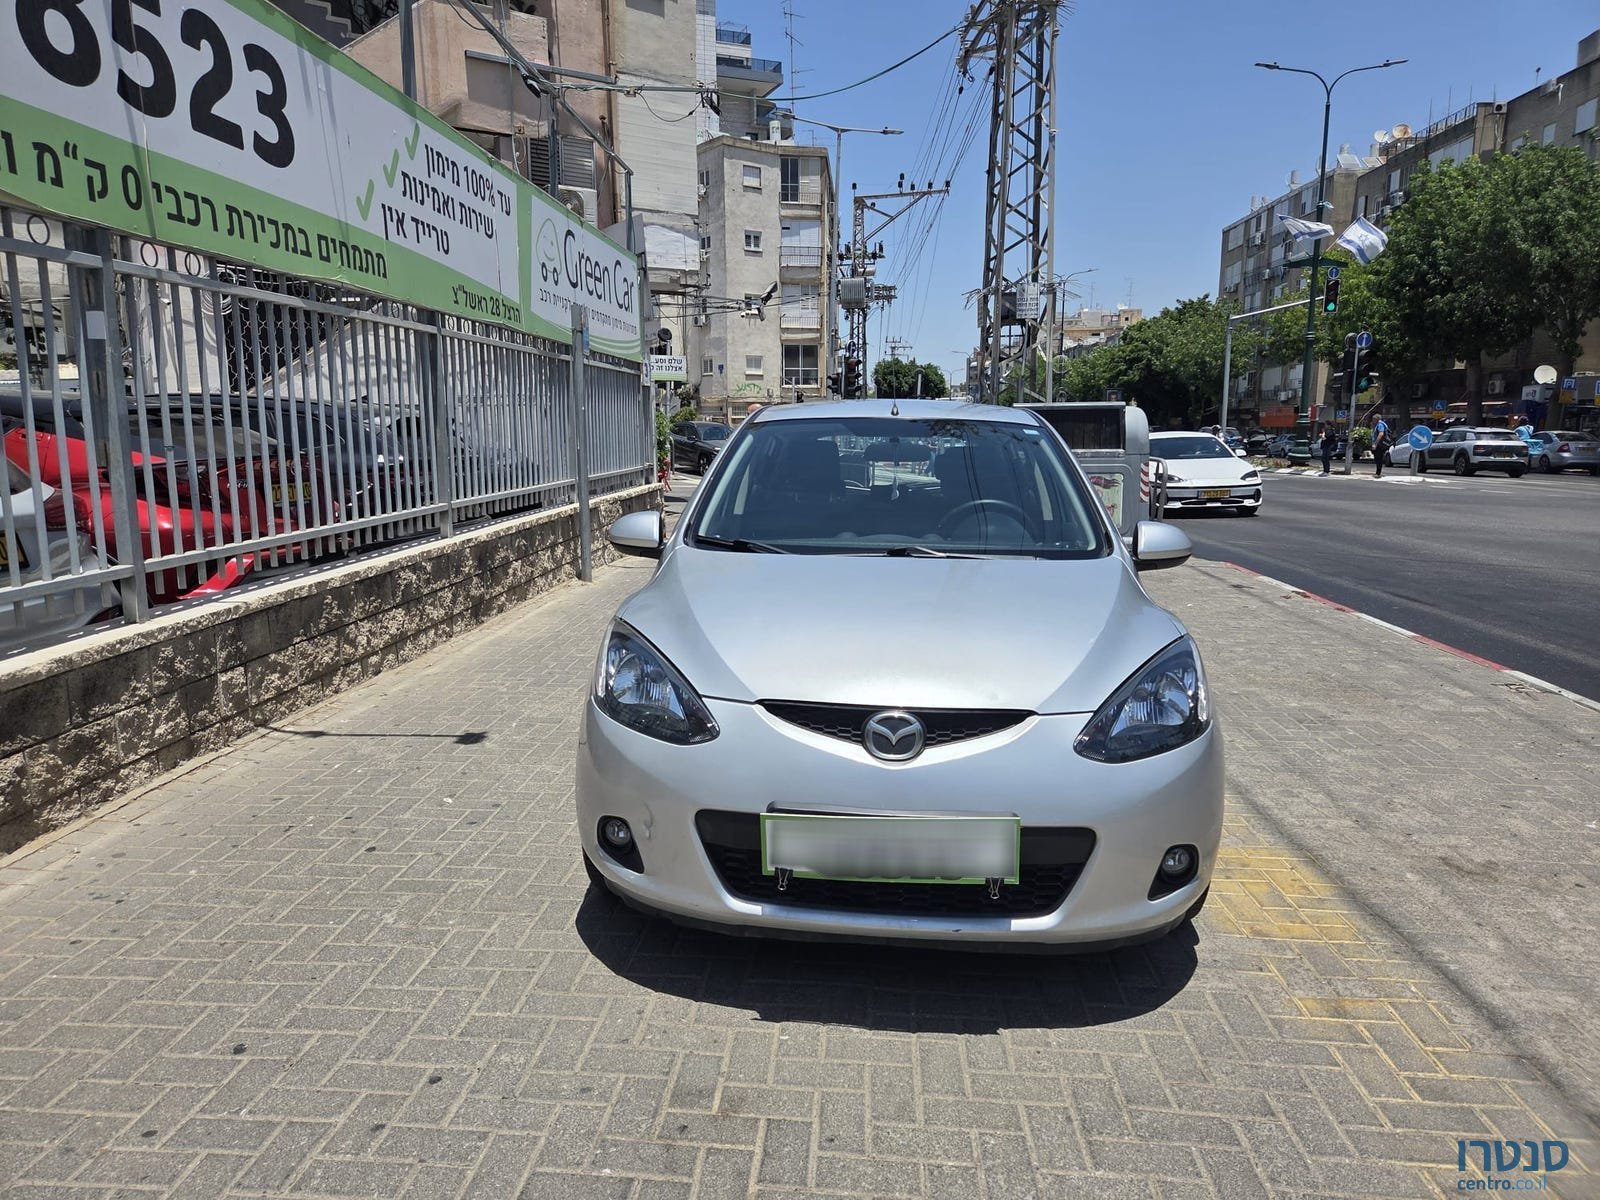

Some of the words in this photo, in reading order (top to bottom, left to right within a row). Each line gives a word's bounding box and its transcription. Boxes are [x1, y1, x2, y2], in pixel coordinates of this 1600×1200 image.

[15, 0, 296, 169] 6523
[32, 140, 109, 202] ק"מ
[425, 143, 461, 187] מימון
[464, 165, 496, 207] 100%
[121, 164, 143, 211] 0
[152, 181, 219, 232] רכבי
[401, 170, 456, 221] ואמינות
[497, 189, 511, 217] עד
[225, 204, 313, 258] במכירת
[381, 203, 408, 240] אין
[411, 216, 450, 255] טרייד
[459, 201, 494, 239] שירות
[317, 233, 388, 279] מתמחים
[564, 229, 612, 304] Green
[613, 259, 634, 313] Car
[489, 296, 501, 317] 28
[501, 297, 521, 323] הרצל
[540, 288, 551, 303] רכב
